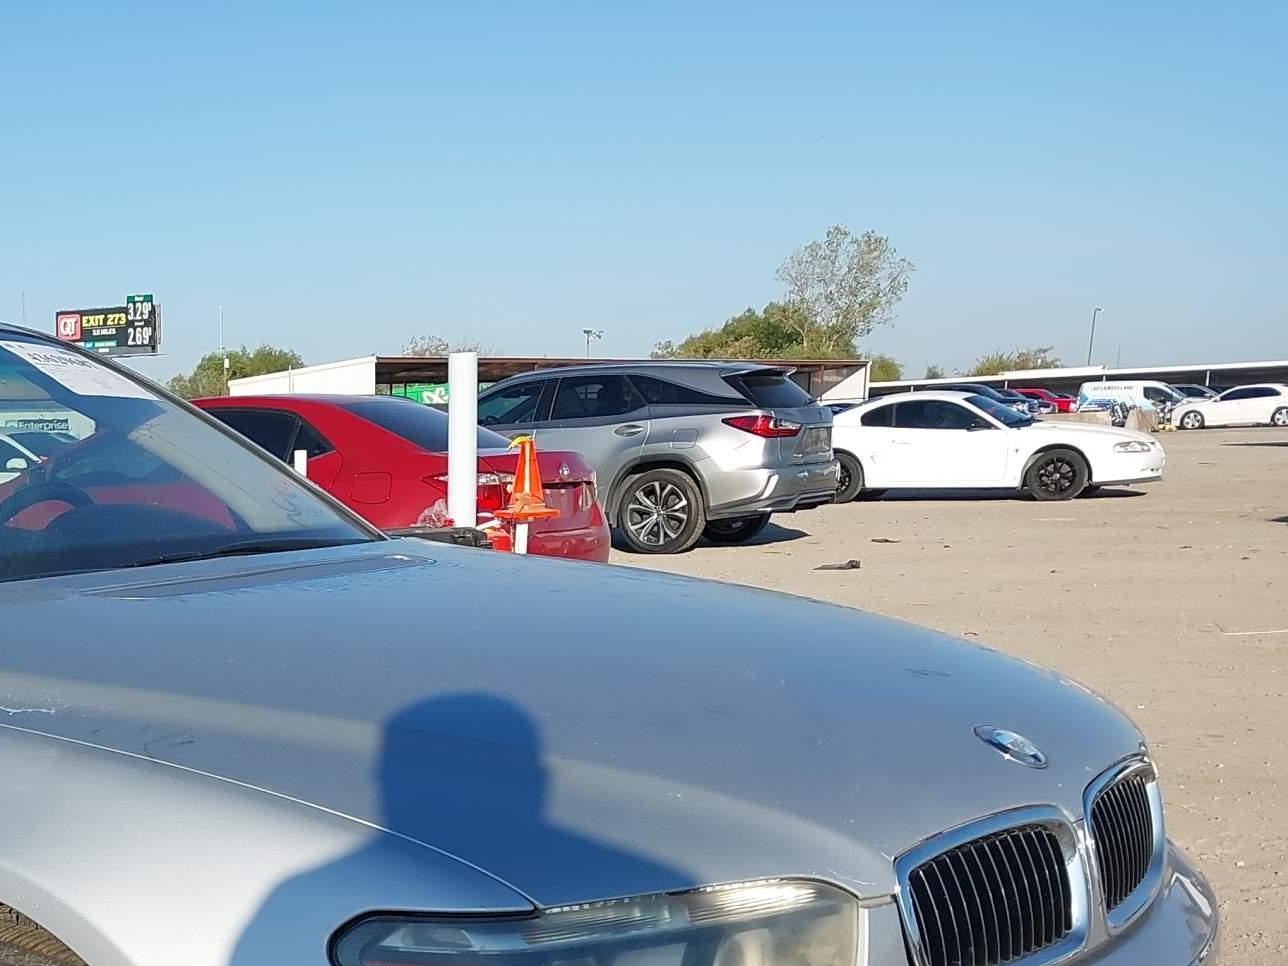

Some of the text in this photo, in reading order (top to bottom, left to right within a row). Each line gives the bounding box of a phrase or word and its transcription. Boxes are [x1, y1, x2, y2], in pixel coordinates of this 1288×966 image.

[82, 314, 105, 327] EXIT
[106, 312, 127, 325] 273
[19, 420, 68, 431] Enterprise
